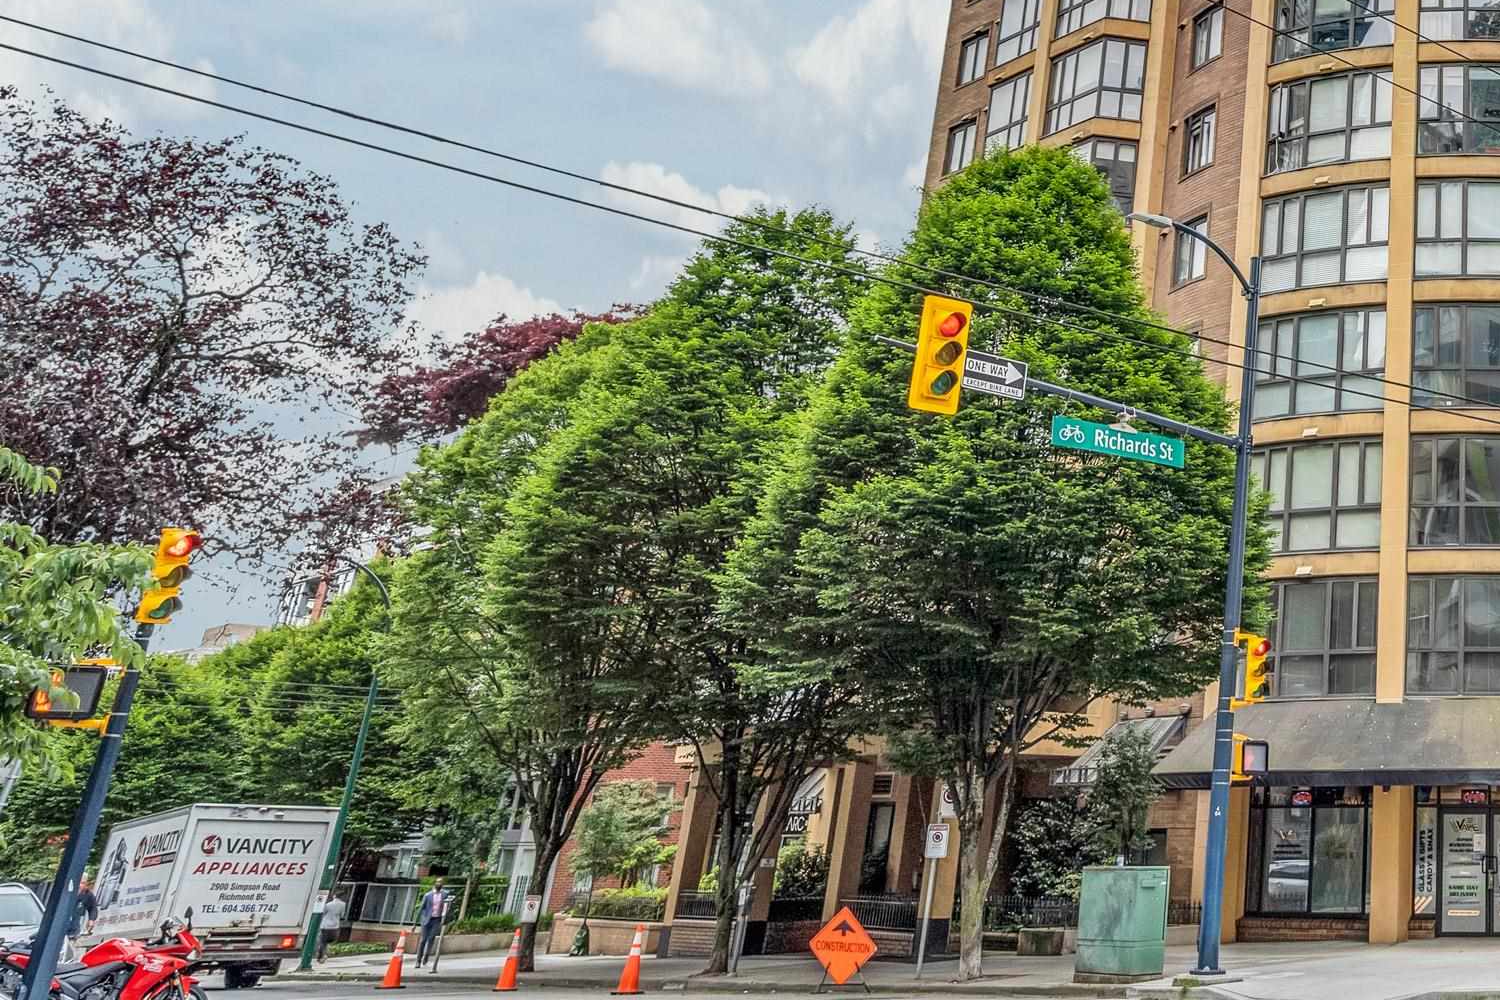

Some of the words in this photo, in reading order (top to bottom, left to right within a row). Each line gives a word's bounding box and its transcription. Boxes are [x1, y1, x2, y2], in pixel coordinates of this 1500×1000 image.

[968, 359, 986, 373] ONE
[990, 364, 1008, 377] WAY
[966, 378, 987, 388] EXCEPT
[1003, 386, 1019, 396] LANE
[1094, 428, 1156, 457] Richards
[1159, 441, 1174, 461] St
[146, 829, 184, 855] VANCITY
[227, 838, 314, 854] VANCITY
[192, 861, 309, 876] APPLIANCES
[230, 882, 260, 892] Simpson
[262, 882, 281, 891] Road
[218, 893, 254, 901] Richmond
[255, 893, 266, 901] BC
[816, 940, 871, 953] CONSTRUCTION
